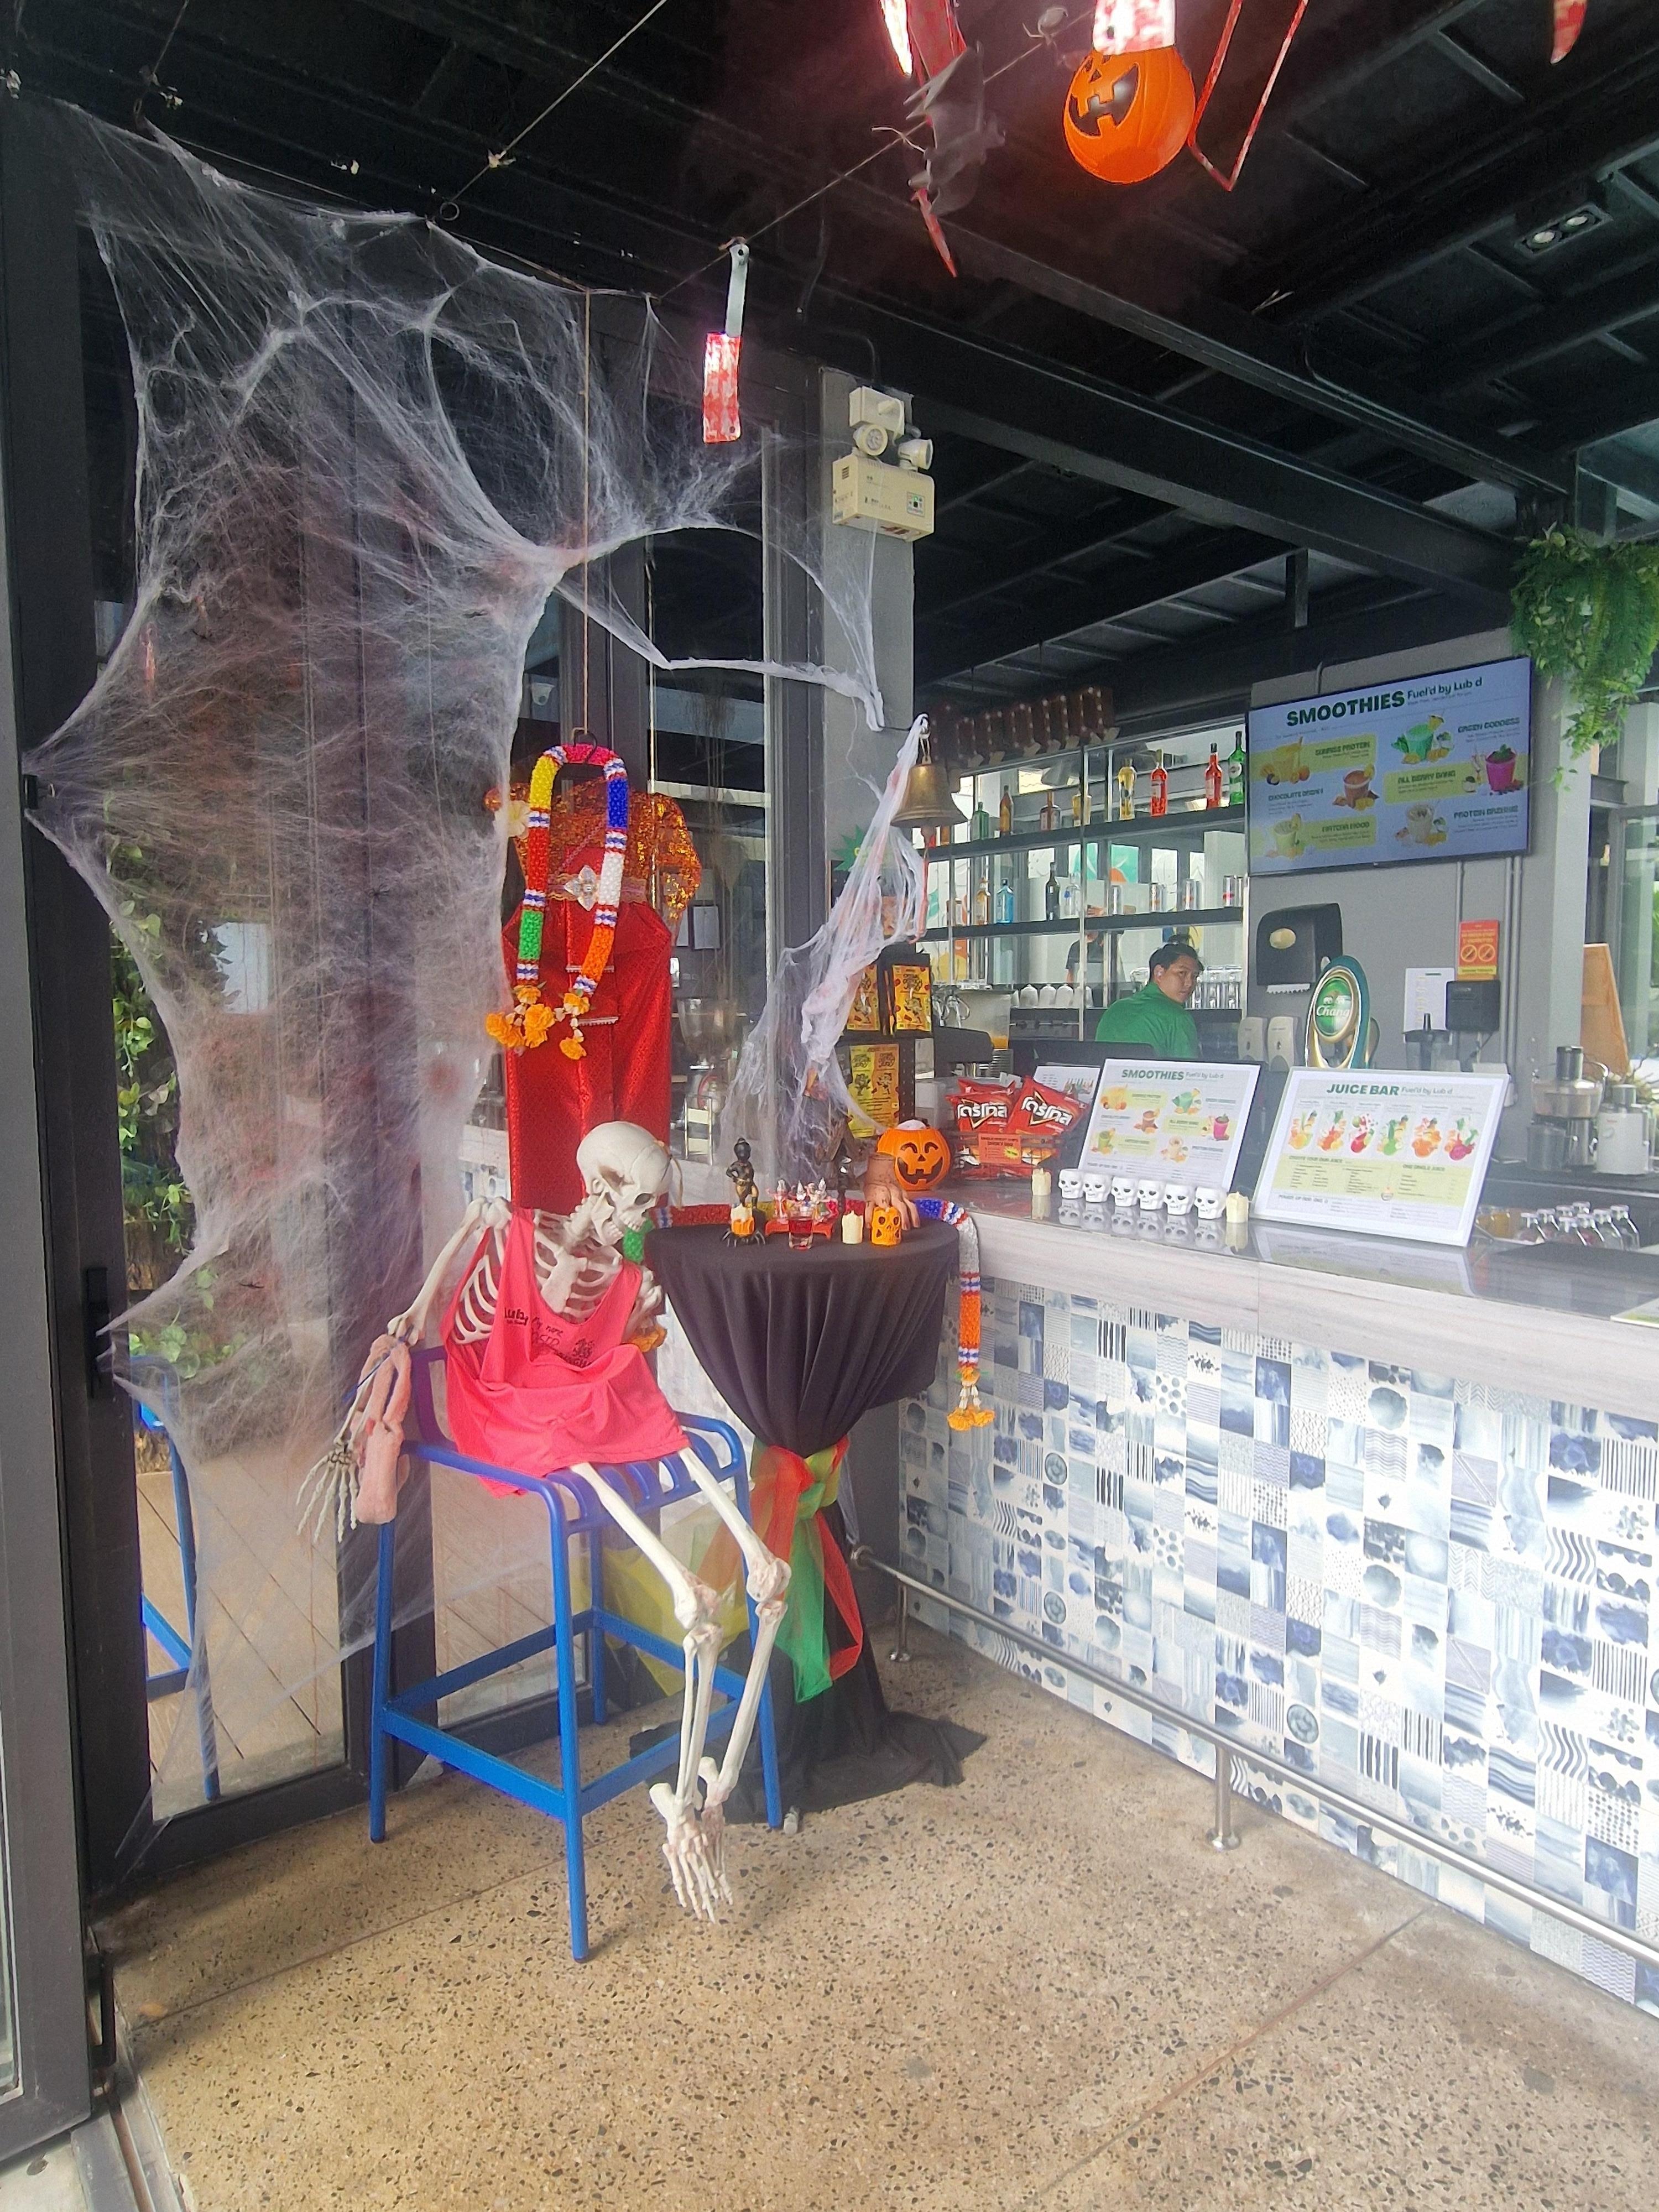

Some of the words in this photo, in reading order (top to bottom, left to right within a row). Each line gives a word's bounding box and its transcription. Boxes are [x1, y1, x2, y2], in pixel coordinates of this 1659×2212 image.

[1287, 691, 1405, 727] SMOOTHIES
[1407, 687, 1437, 700] Fuel'd
[1438, 684, 1452, 695] by
[1454, 681, 1473, 691] Lub
[1475, 677, 1483, 687] d
[1317, 1005, 1350, 1018] Chang
[1121, 1069, 1185, 1081] SMOOTHIES
[1326, 1083, 1369, 1094] JUICE
[1369, 1085, 1400, 1095] BAR
